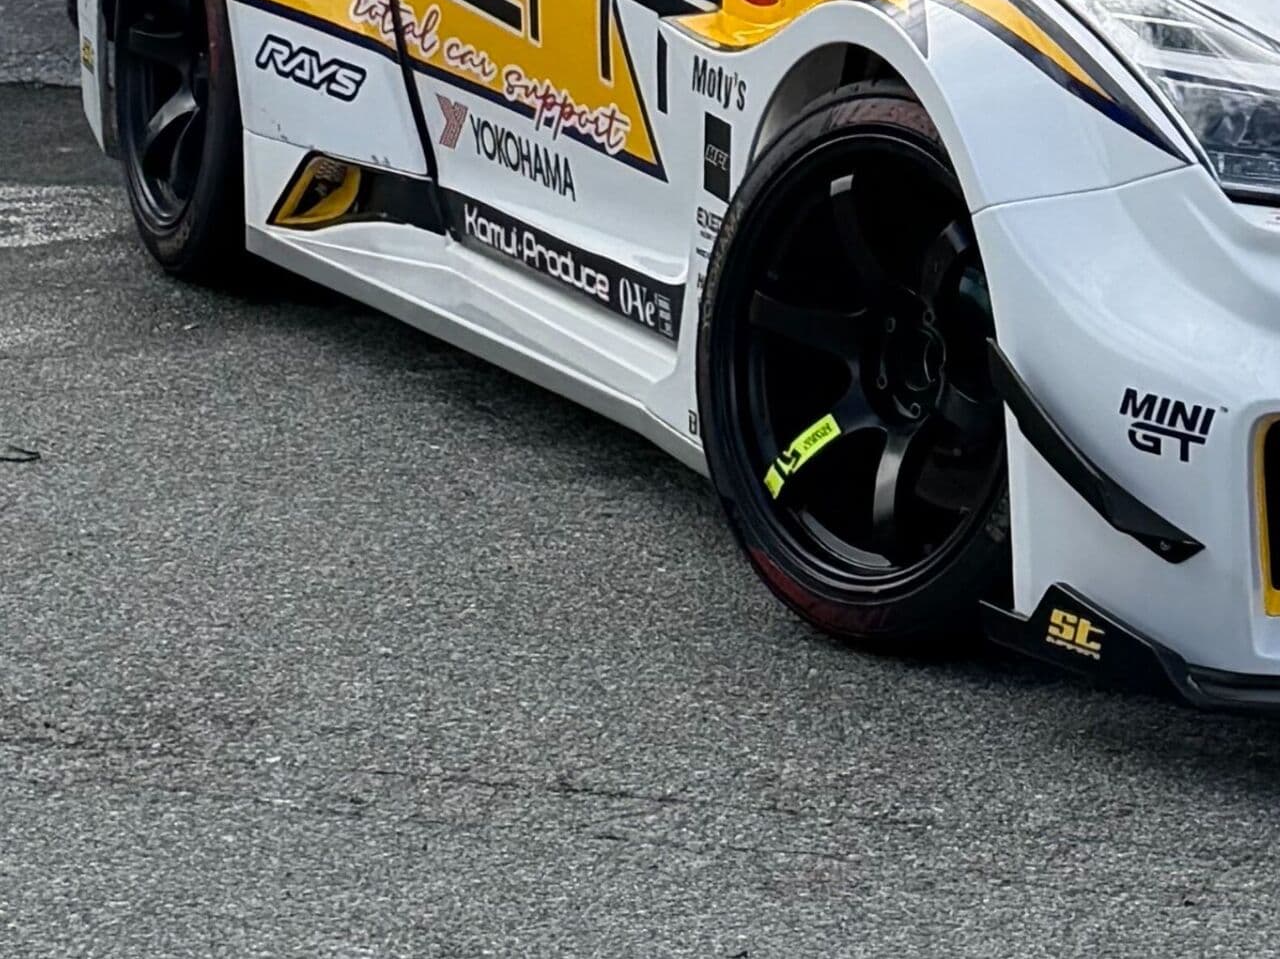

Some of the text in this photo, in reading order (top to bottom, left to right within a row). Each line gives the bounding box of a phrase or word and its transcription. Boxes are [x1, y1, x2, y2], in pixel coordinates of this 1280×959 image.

[256, 34, 366, 102] RAYS
[446, 41, 495, 78] car
[505, 69, 630, 150] support
[692, 55, 747, 111] Moty's
[470, 114, 577, 201] YOKOHAMA
[1119, 387, 1216, 436] MINI
[1127, 421, 1206, 462] GT
